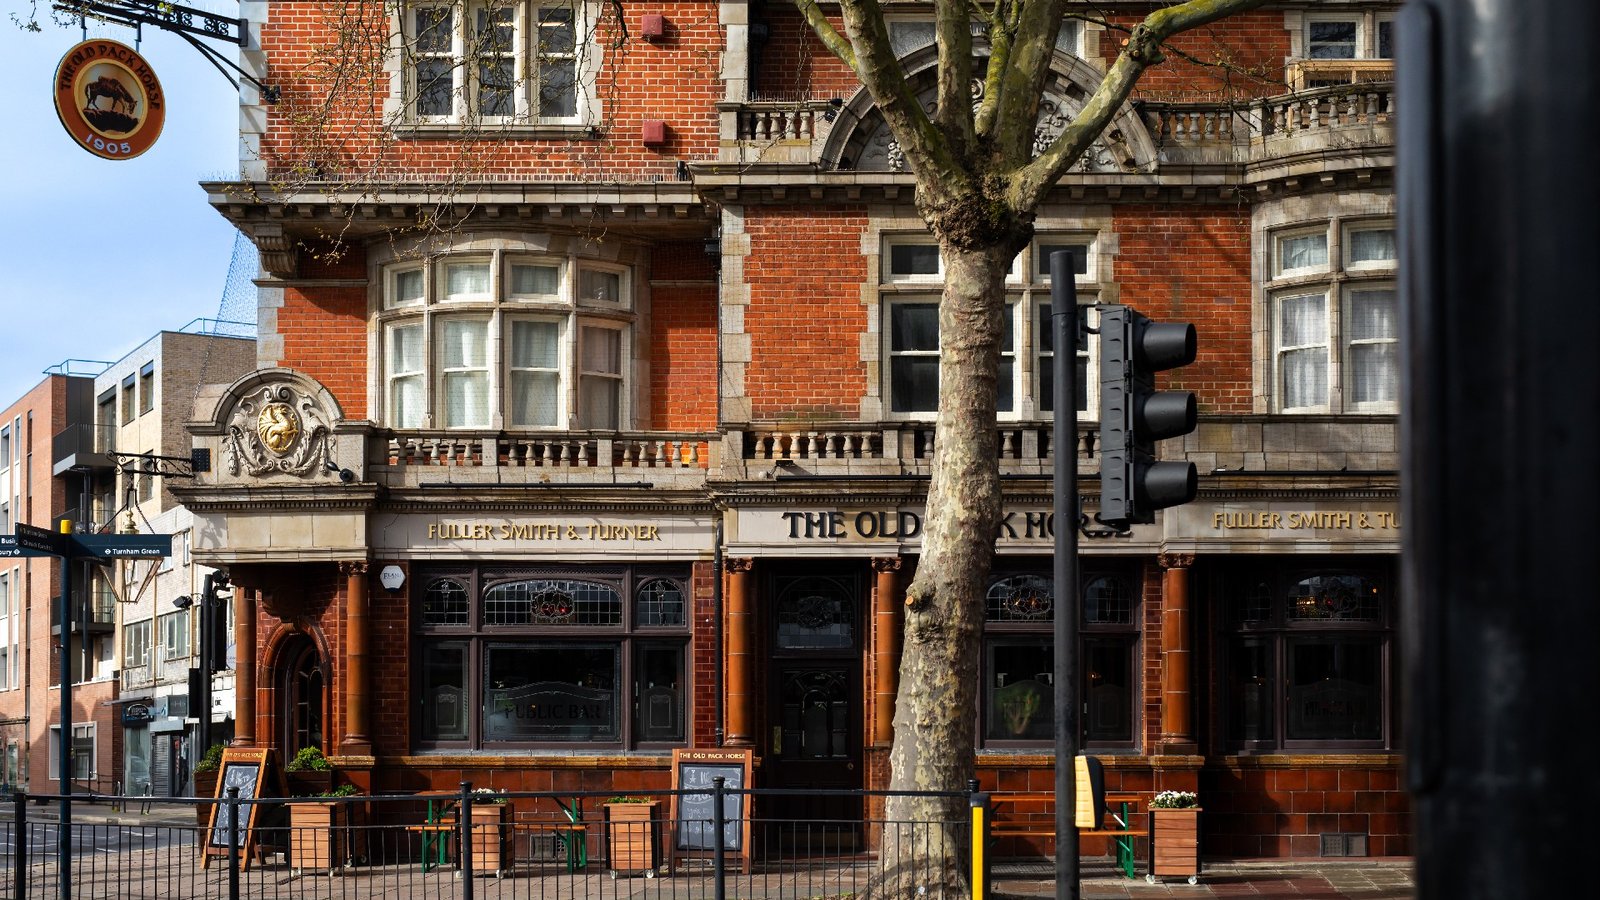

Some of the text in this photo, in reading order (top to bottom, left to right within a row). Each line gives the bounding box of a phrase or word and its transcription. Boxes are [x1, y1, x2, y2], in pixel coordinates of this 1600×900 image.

[60, 44, 160, 110] THE OLD PACK HORSE
[85, 133, 131, 154] 1905
[781, 511, 847, 539] THE
[854, 511, 921, 539] OLD
[1212, 512, 1283, 529] FULLER
[1288, 512, 1352, 529] SMITH
[1358, 512, 1374, 529] &
[427, 523, 661, 541] FULLER SMITH & TURNER
[504, 703, 601, 719] PUBLIC BAR
